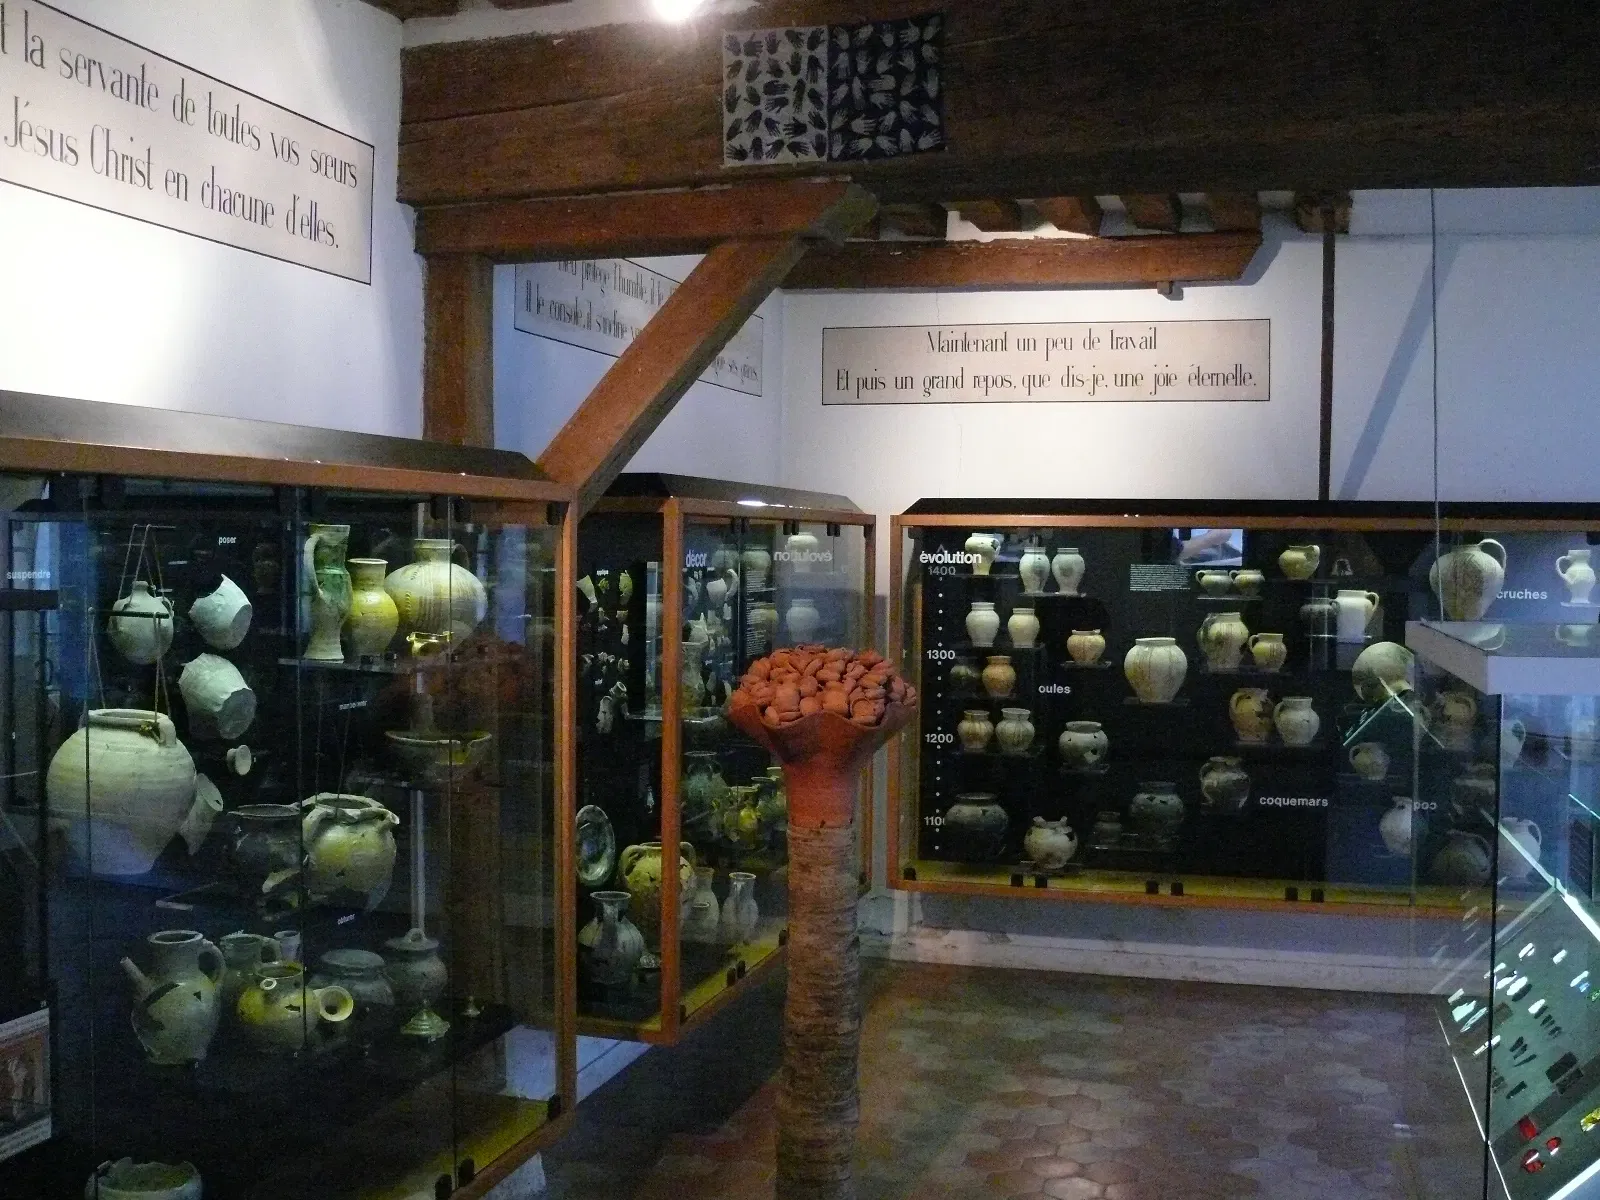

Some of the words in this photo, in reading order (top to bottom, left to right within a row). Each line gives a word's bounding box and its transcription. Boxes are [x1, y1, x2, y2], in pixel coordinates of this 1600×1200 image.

[23, 9, 46, 70] la
[58, 46, 160, 113] servante
[172, 77, 197, 127] de
[206, 90, 262, 152] toutes
[269, 130, 301, 167] vos
[309, 148, 358, 189] sœurs
[3, 95, 80, 167] Jésus
[89, 123, 155, 191] Christ
[163, 167, 189, 202] en
[200, 164, 276, 229] chacune
[285, 193, 340, 249] d'elles.
[927, 330, 1008, 353] Maintenant
[1016, 336, 1037, 352] un
[1045, 335, 1073, 362] peu
[1082, 328, 1101, 351] de
[1110, 326, 1158, 350] travail
[836, 368, 850, 391] Et
[856, 368, 886, 400] puis
[894, 375, 914, 390] un
[922, 366, 964, 398] grand
[972, 373, 1017, 397] repos,
[1021, 371, 1051, 397] que
[1113, 371, 1144, 388] une
[1149, 363, 1178, 396] joie
[1187, 362, 1258, 388] éternelle.
[218, 536, 237, 546] poser
[685, 548, 708, 568] décor
[919, 550, 982, 565] évolution
[6, 569, 51, 581] suspendre
[927, 565, 957, 576] 1400
[1496, 588, 1548, 600] cruches
[926, 649, 956, 660] 1300
[1038, 683, 1071, 694] oules
[925, 733, 954, 744] 1200
[1259, 795, 1329, 807] coquemars
